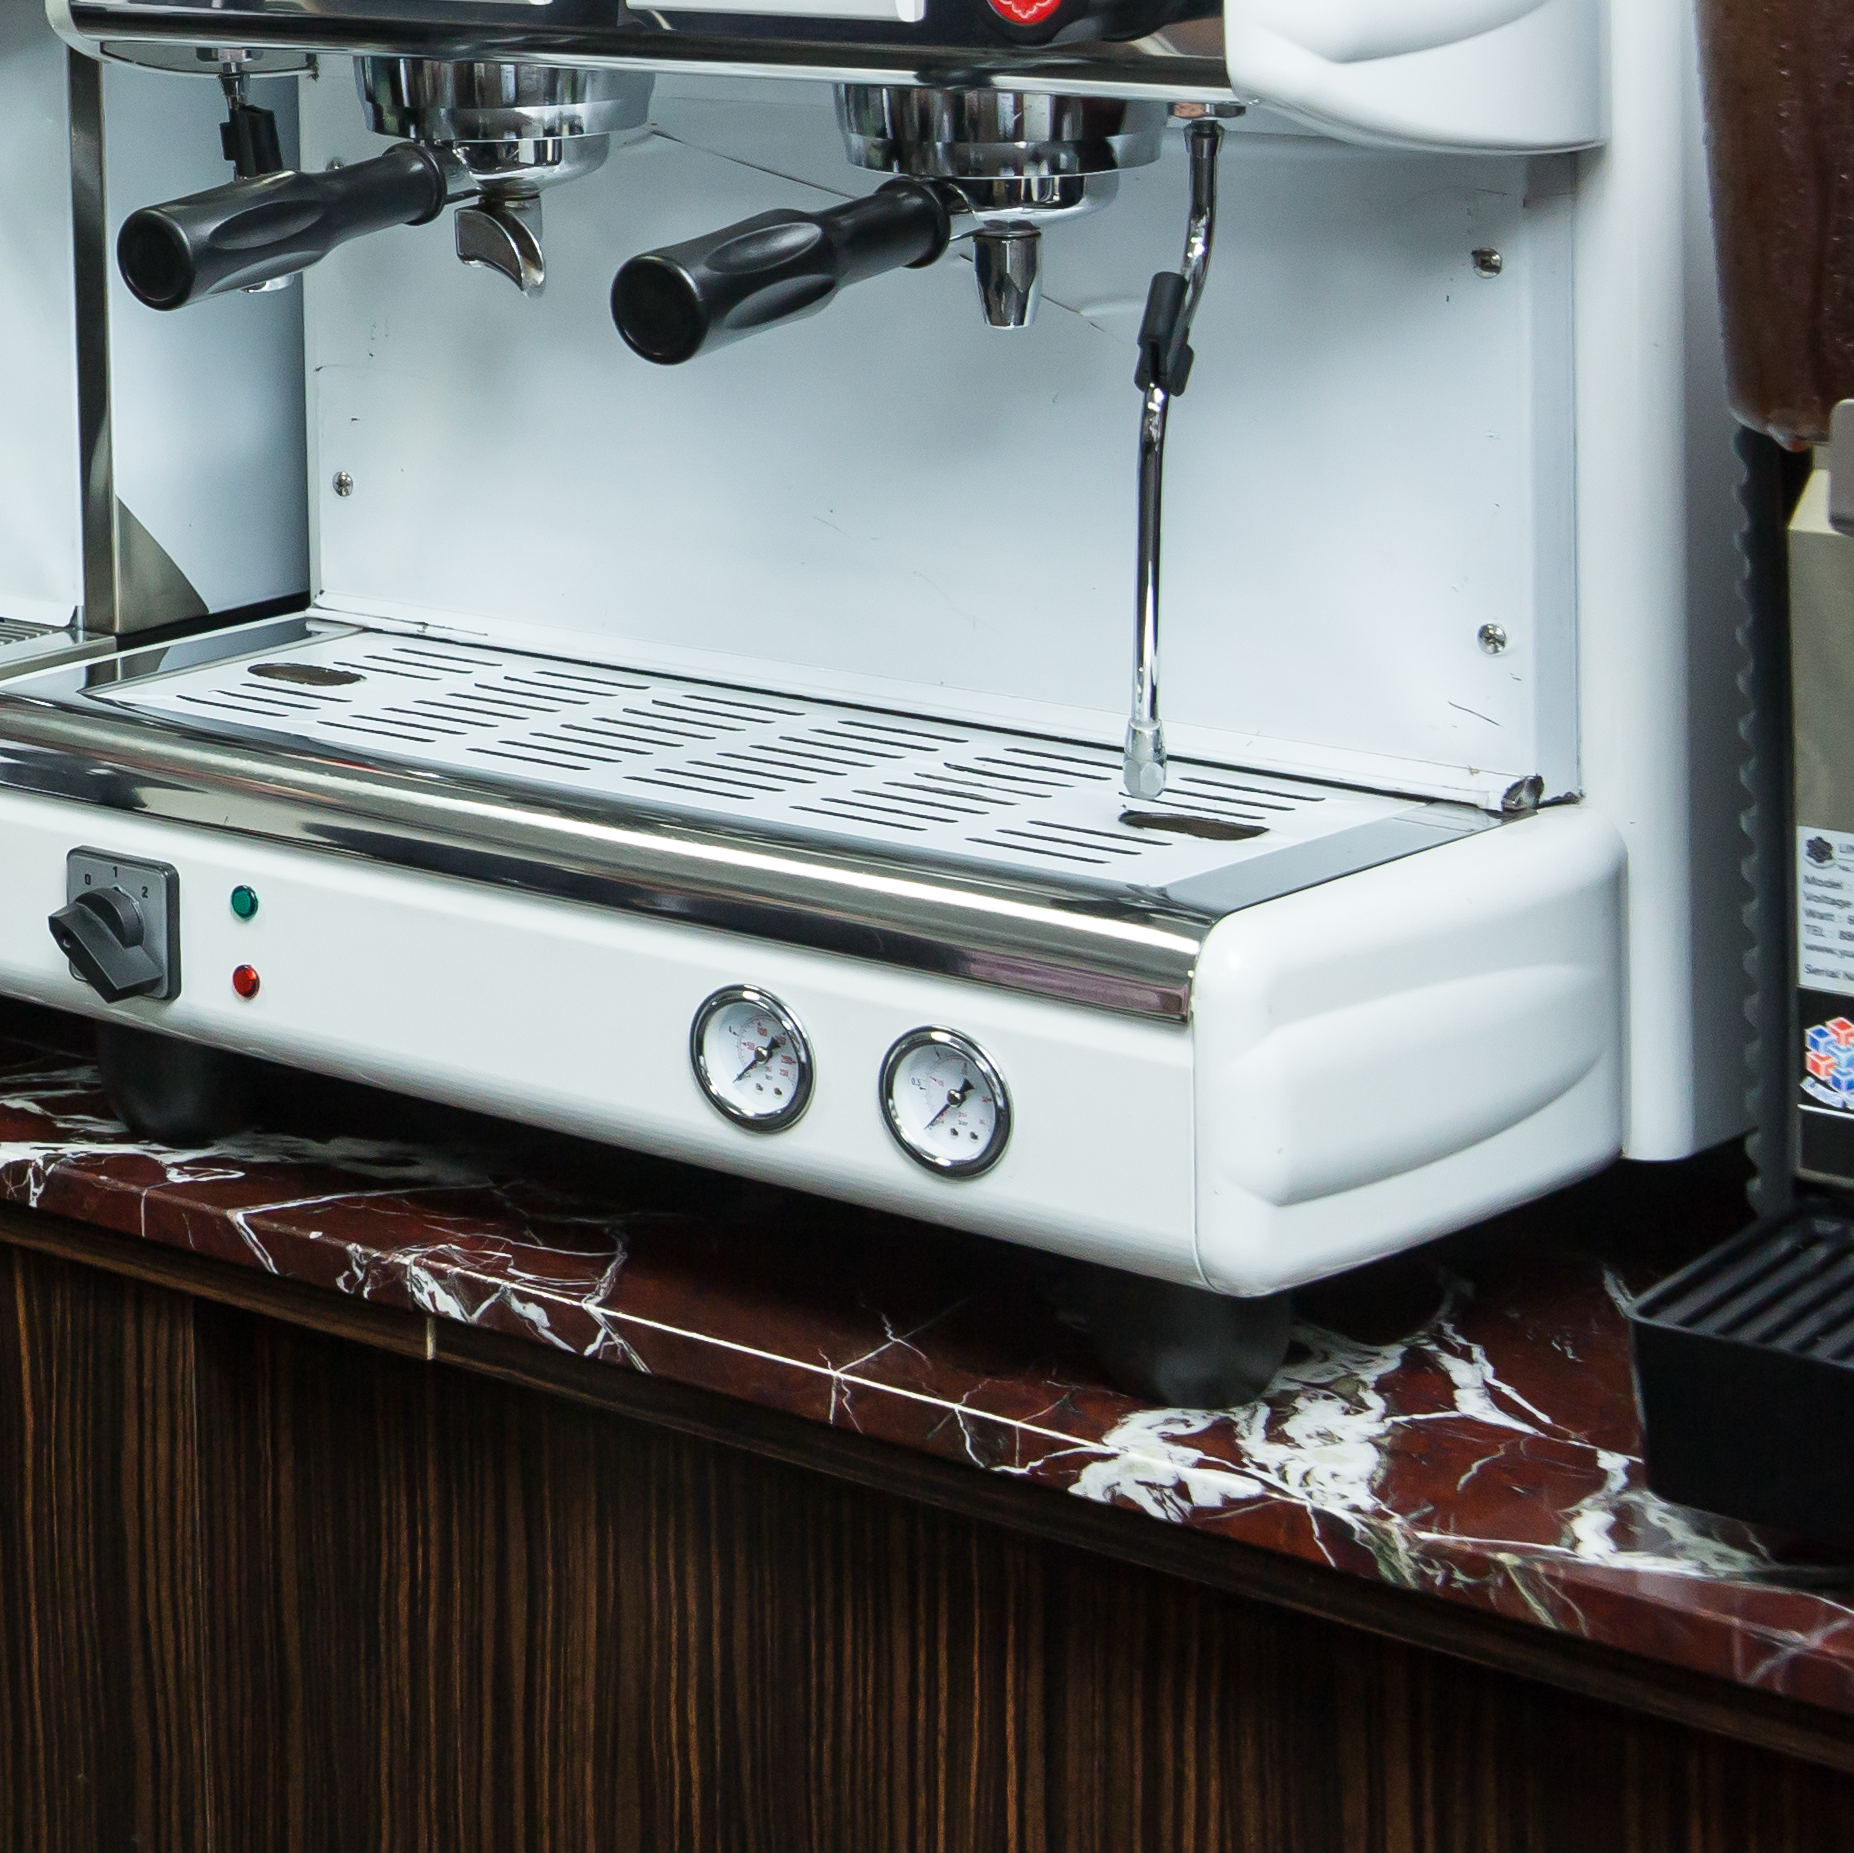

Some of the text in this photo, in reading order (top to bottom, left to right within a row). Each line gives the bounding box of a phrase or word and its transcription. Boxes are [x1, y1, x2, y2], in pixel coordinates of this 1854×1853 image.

[84, 866, 148, 898] 0 1 2
[911, 1077, 922, 1087] 0.5
